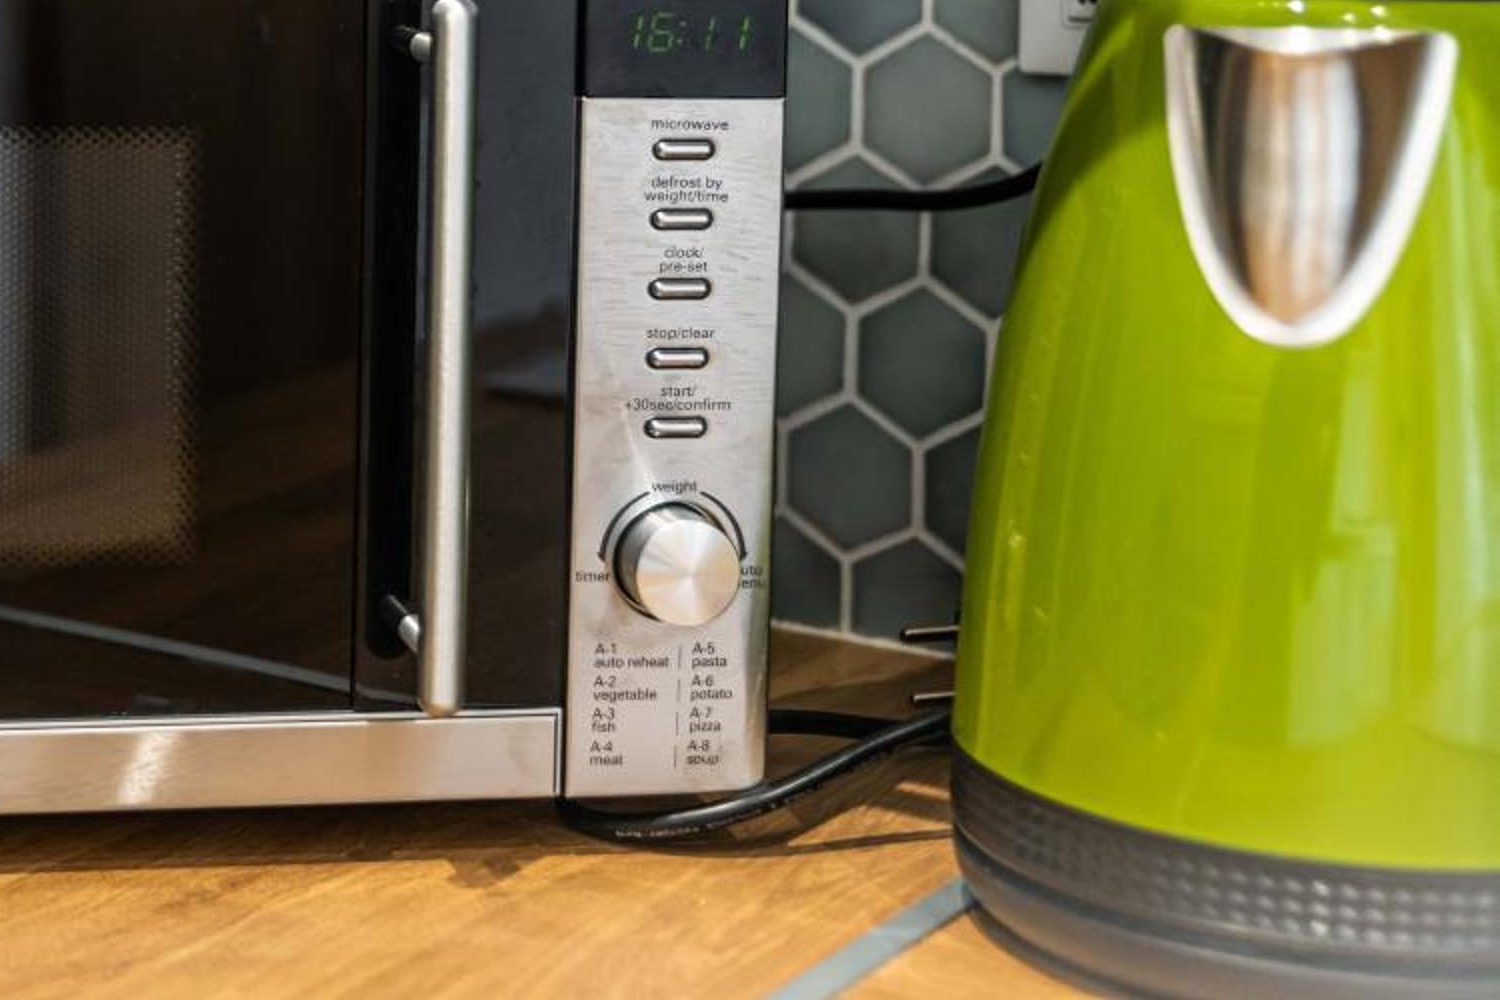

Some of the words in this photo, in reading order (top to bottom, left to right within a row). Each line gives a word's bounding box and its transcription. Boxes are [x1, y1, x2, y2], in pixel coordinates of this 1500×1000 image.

[633, 12, 751, 51] 16:11
[651, 119, 729, 131] microwave
[651, 176, 701, 189] defrost
[705, 177, 723, 191] by
[644, 190, 729, 204] weight/time
[664, 246, 704, 259] clock/
[659, 260, 708, 273] pre-set
[646, 328, 715, 340] stop/clear
[660, 386, 697, 398] start/
[625, 399, 731, 411] +30sec/confirm
[652, 481, 697, 495] weight
[576, 570, 611, 582] timer
[740, 565, 764, 577] uto
[739, 579, 766, 589] enu
[595, 643, 617, 654] A-1
[692, 642, 715, 654] A-5
[593, 657, 625, 669] auto
[627, 657, 669, 668] reheat
[691, 657, 727, 669] pasta
[593, 675, 617, 688] A-2
[691, 675, 714, 687] A-6
[593, 688, 657, 703] vegetable
[690, 689, 733, 701] potato
[592, 707, 615, 720] A-3
[690, 707, 712, 719] A-7
[591, 721, 616, 733] fish
[689, 721, 721, 733] pizza
[590, 740, 613, 752] A-4
[687, 739, 710, 752] A-8
[589, 754, 623, 766] meat
[686, 754, 719, 766] soup
